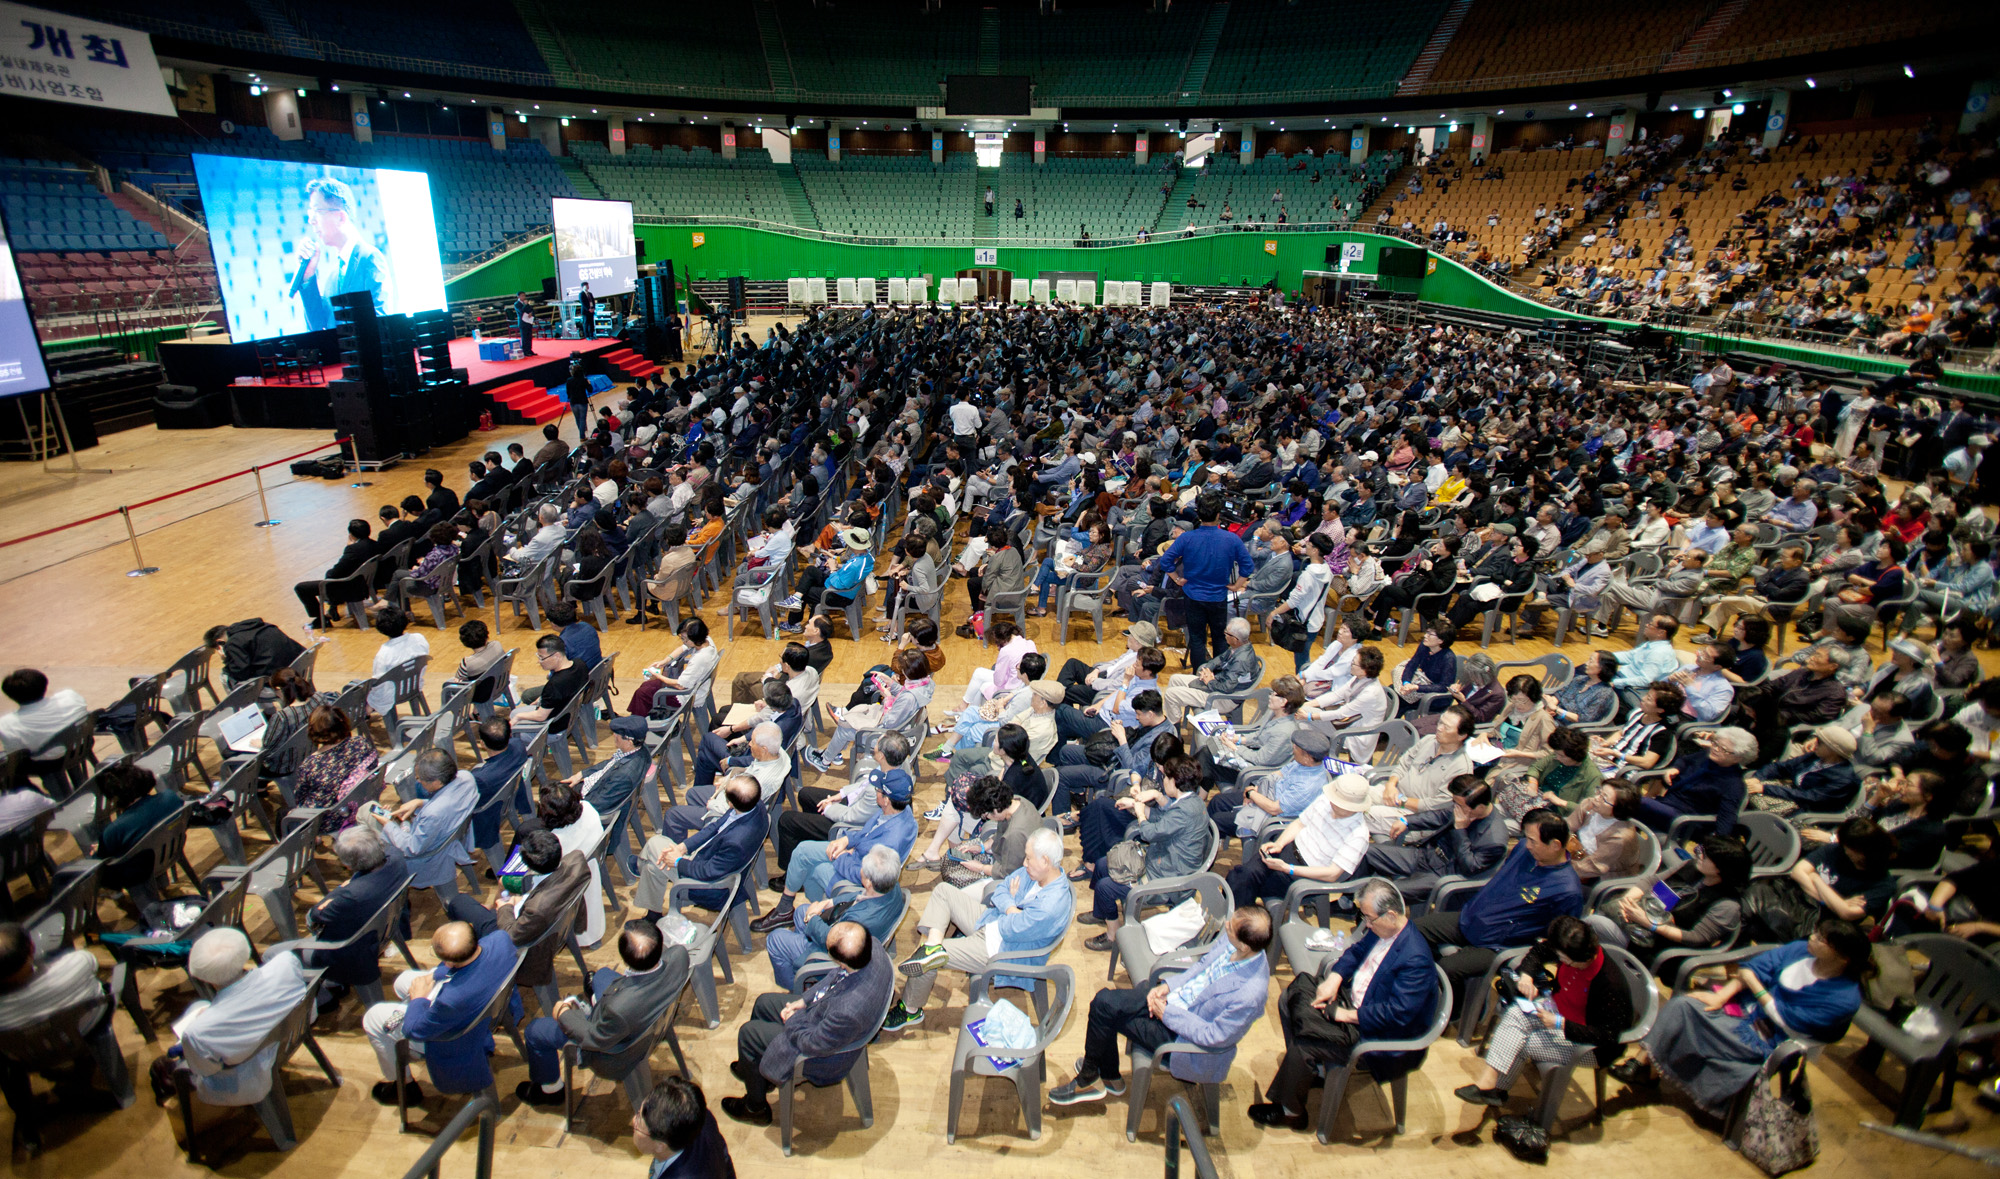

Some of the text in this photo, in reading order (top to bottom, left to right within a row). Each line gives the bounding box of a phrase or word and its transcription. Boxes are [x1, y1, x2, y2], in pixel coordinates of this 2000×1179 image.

[21, 19, 130, 68] 개최
[693, 235, 704, 243] S2
[1265, 242, 1276, 251] S3
[976, 250, 995, 262] 내1문
[1428, 262, 1436, 270] S4
